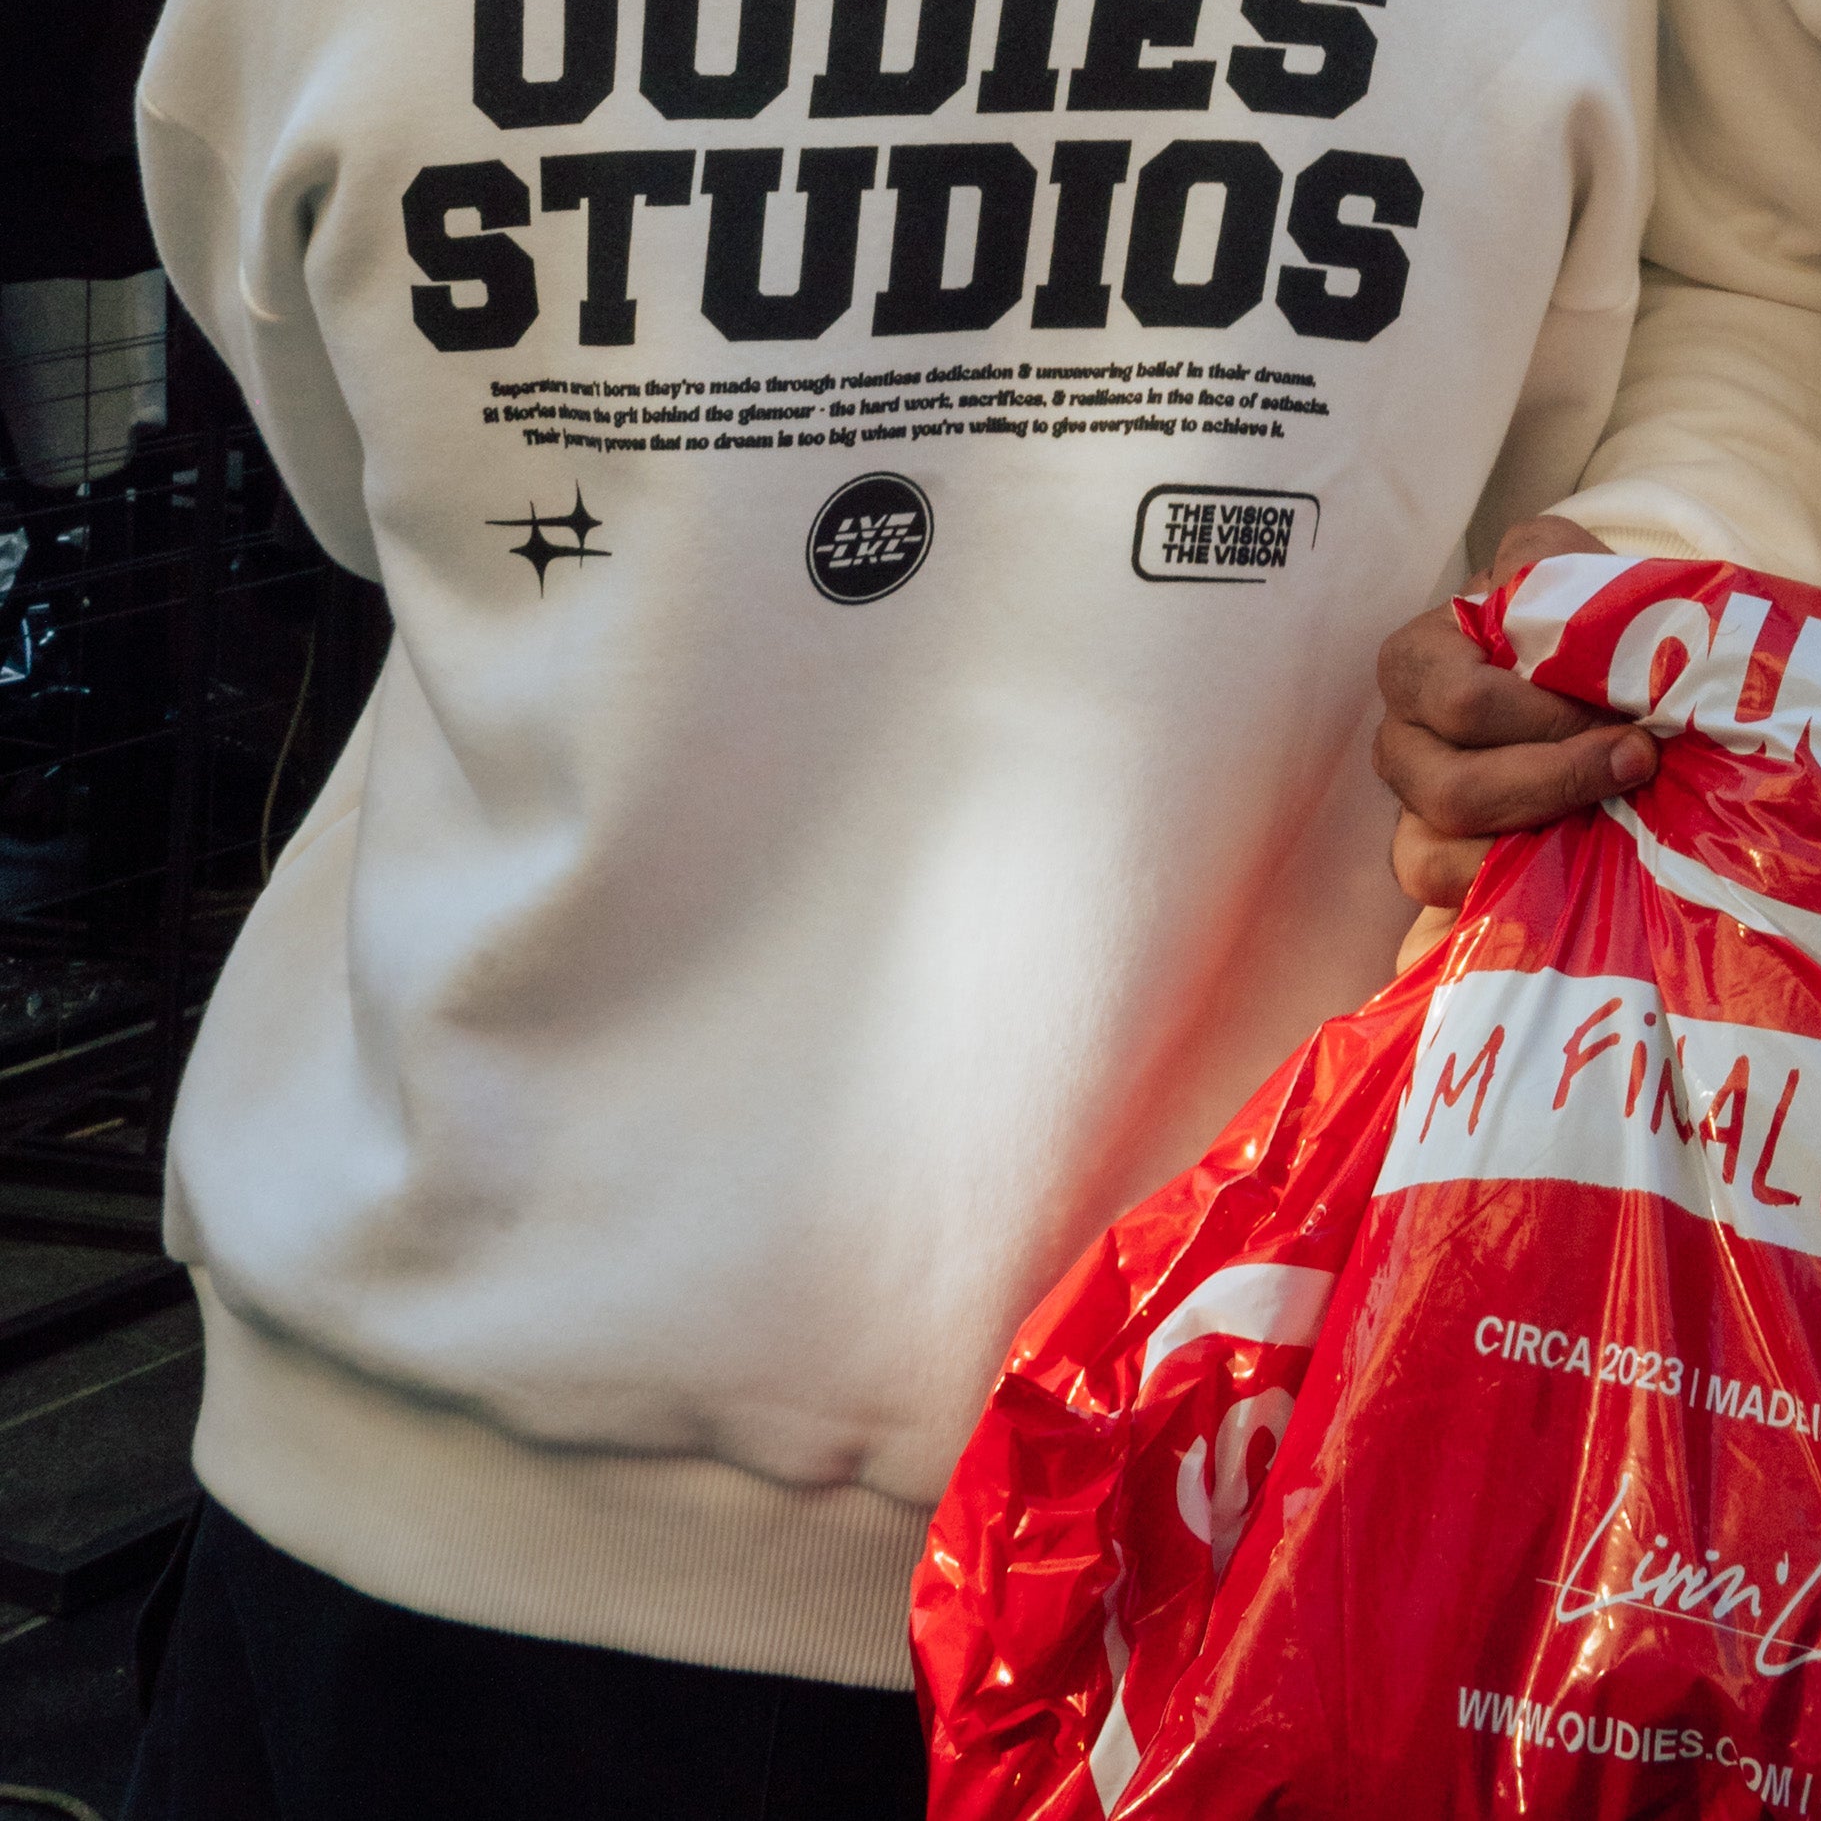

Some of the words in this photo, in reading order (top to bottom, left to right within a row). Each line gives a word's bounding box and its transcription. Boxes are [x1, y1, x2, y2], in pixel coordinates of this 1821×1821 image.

[401, 139, 1425, 353] STUDIOS
[645, 379, 705, 399] they're
[709, 377, 761, 395] made
[765, 374, 836, 395] through
[840, 370, 921, 389] relentless
[926, 364, 1014, 383] dedication
[1036, 362, 1134, 383] unwavering
[1136, 361, 1184, 378] belief
[1187, 361, 1203, 379] in
[1208, 364, 1251, 380] their
[613, 406, 638, 428] grit
[642, 406, 700, 423] behind
[705, 405, 734, 422] the
[738, 404, 815, 425] glamour
[829, 401, 856, 418] the
[859, 396, 900, 415] hard
[1069, 389, 1143, 407] resilience
[1146, 387, 1163, 405] in
[1167, 388, 1193, 405] the
[1198, 389, 1235, 407] face
[1239, 392, 1259, 409] of
[650, 433, 681, 451] that
[685, 436, 709, 451] no
[714, 432, 773, 450] dream
[777, 430, 793, 448] is
[798, 431, 825, 446] too
[828, 427, 856, 447] big
[861, 424, 907, 441] when
[911, 419, 965, 441] you're
[969, 416, 1029, 438] willing
[1032, 419, 1049, 434] to
[1052, 417, 1087, 439] give
[1090, 414, 1177, 436] everything
[1181, 416, 1198, 433] to
[1202, 417, 1268, 437] achieve
[1168, 503, 1216, 523] THE
[1219, 505, 1295, 528] VISION
[1165, 523, 1213, 544] THE
[1216, 525, 1291, 547] VISION
[1162, 543, 1210, 564] THE
[1214, 545, 1288, 567] VISION
[1474, 1315, 1592, 1377] CIRCA
[1599, 1341, 1684, 1397] 2023
